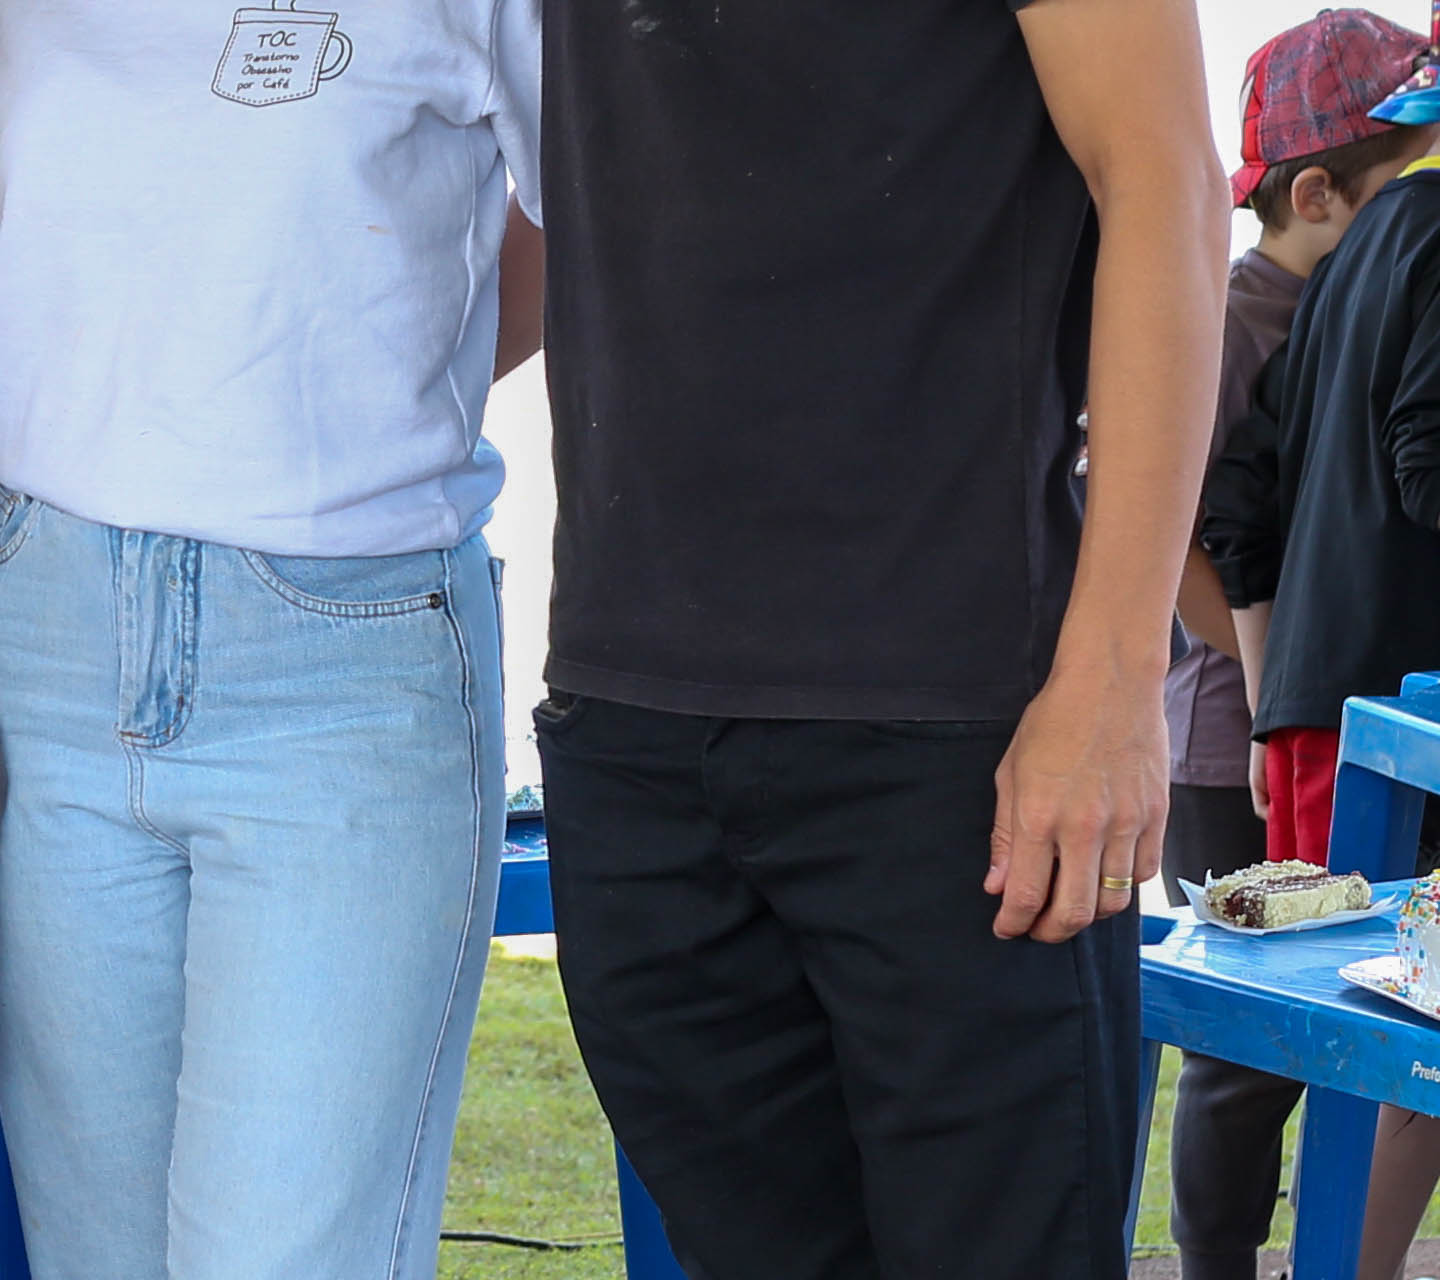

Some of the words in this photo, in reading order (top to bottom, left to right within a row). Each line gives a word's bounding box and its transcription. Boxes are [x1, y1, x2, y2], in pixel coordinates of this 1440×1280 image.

[257, 30, 297, 49] TOC
[243, 51, 301, 63] Transtorno
[241, 64, 293, 76] Obsessivo
[236, 81, 255, 94] por
[263, 77, 291, 90] Café
